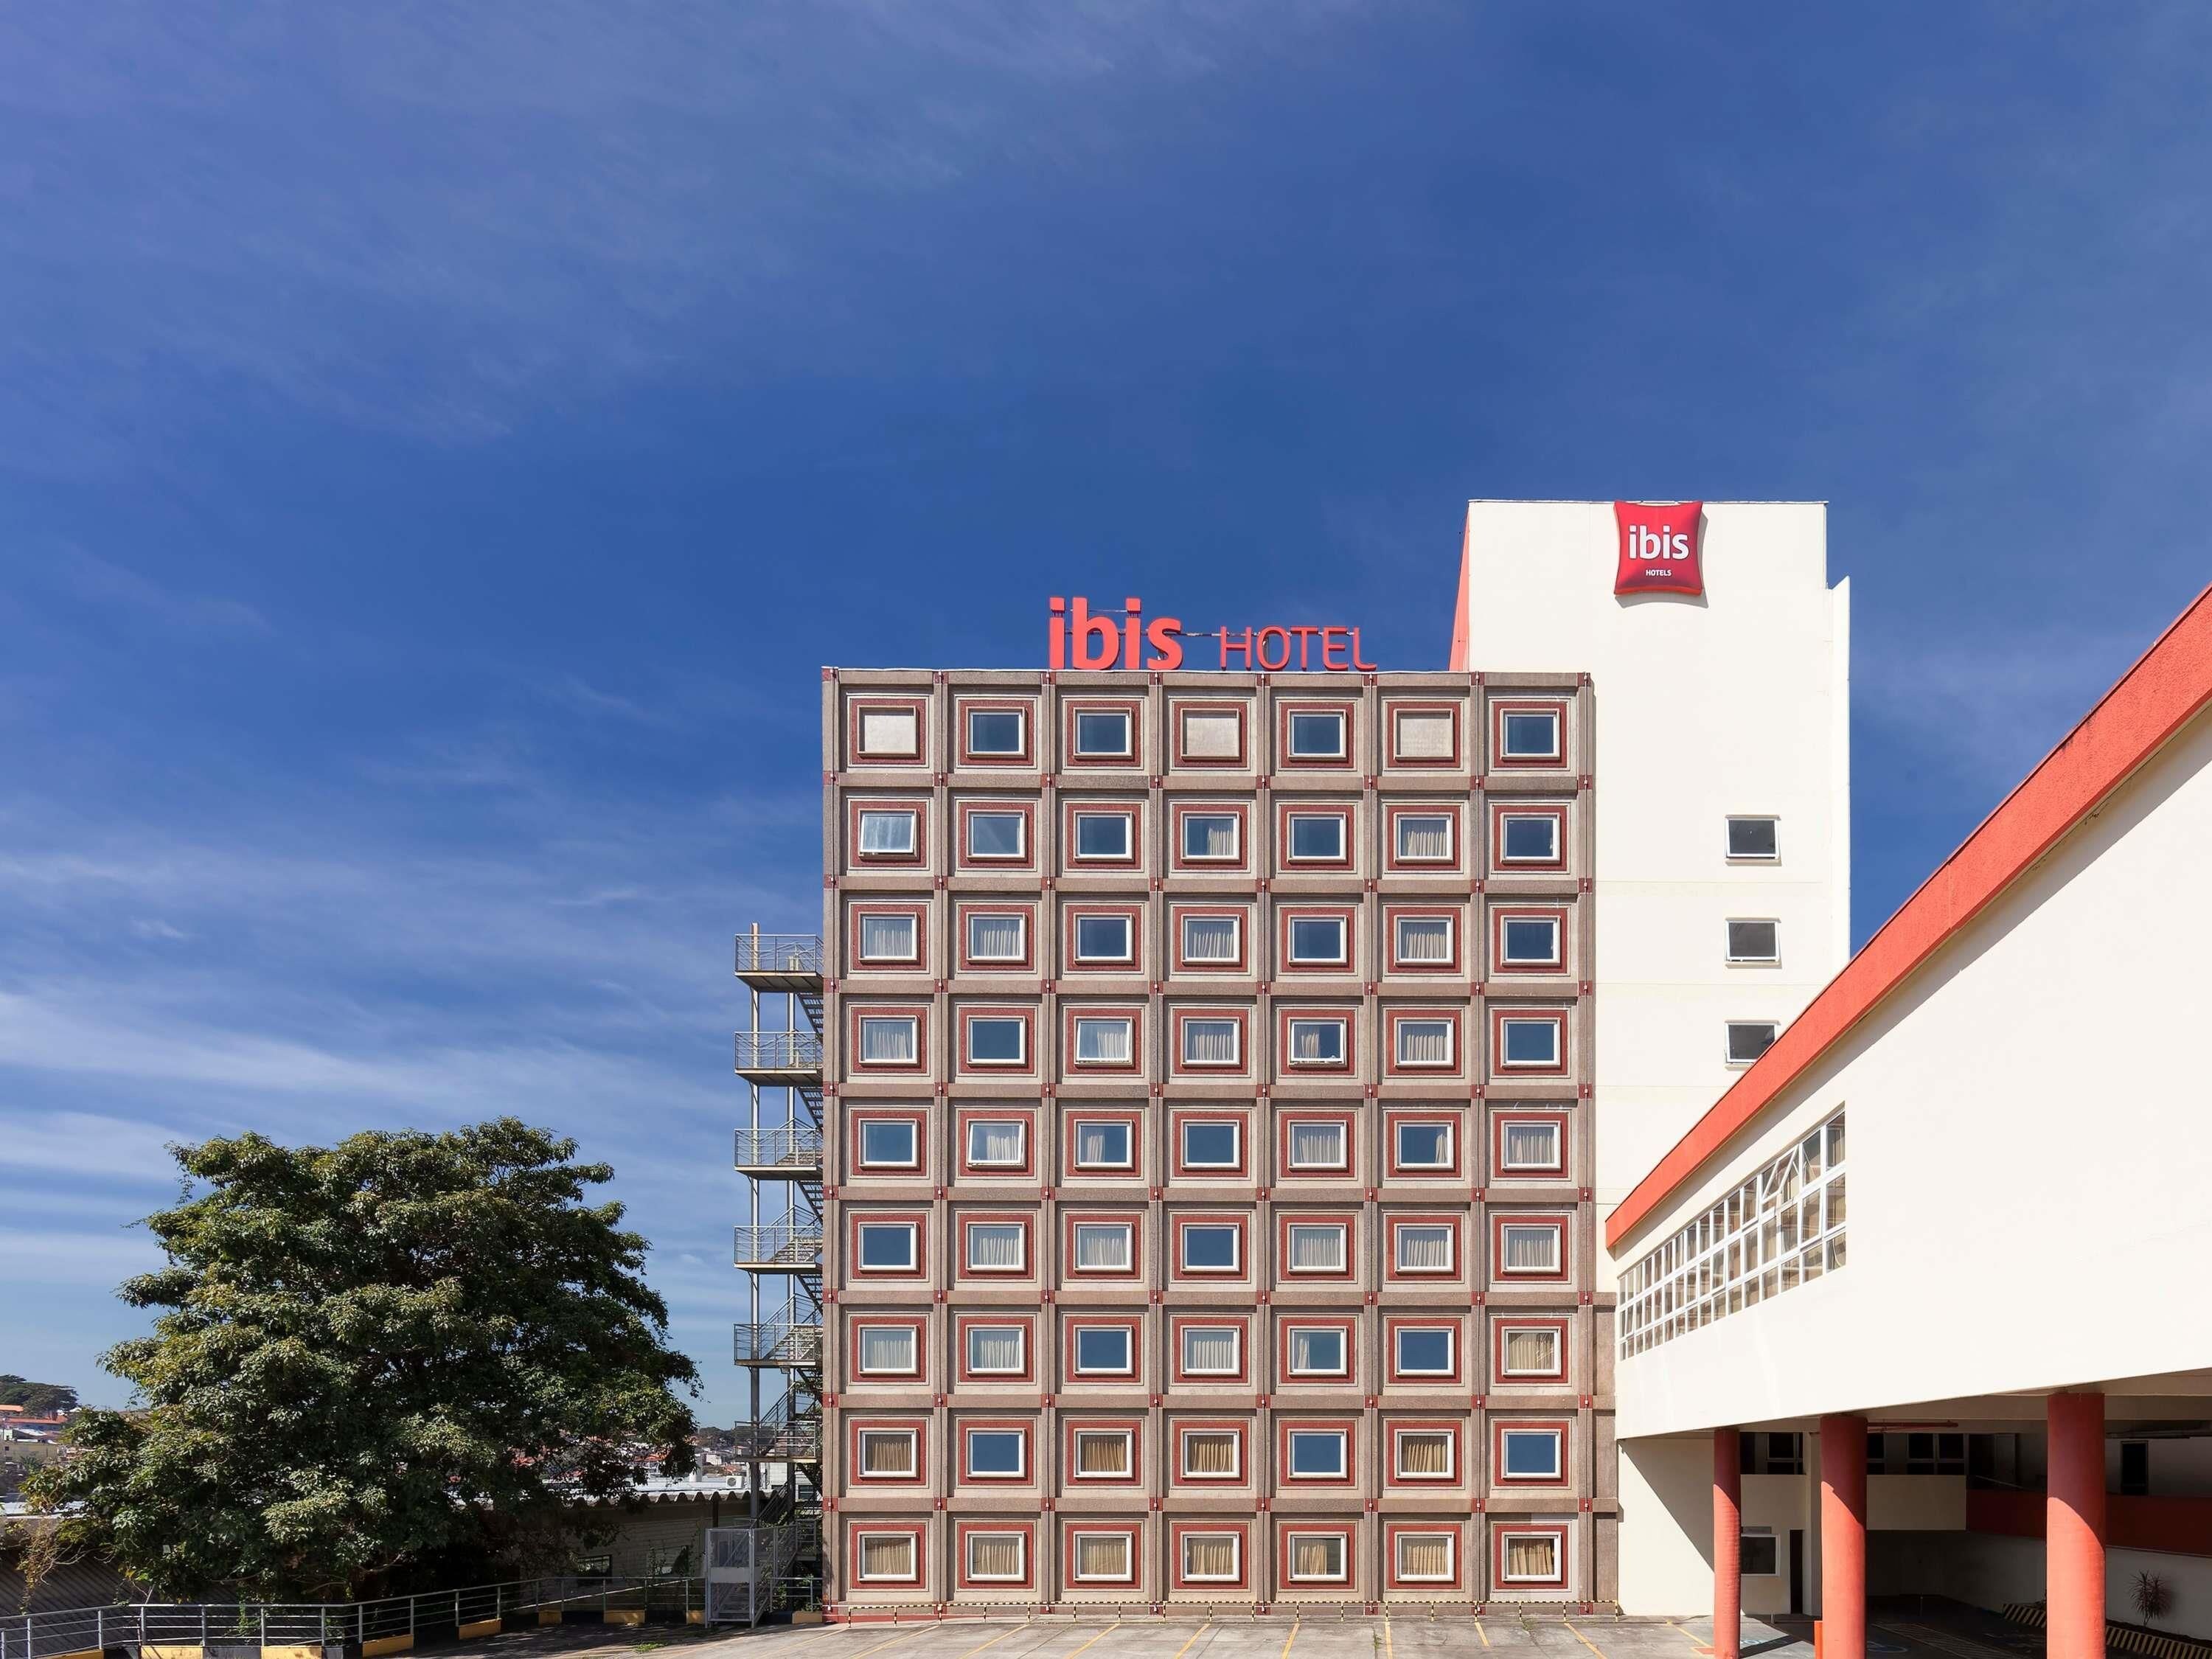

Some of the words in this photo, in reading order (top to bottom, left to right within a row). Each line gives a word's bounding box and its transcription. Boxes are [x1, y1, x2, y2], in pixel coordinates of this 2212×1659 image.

[1630, 526, 1689, 559] ibis
[1049, 597, 1183, 669] ibis
[1220, 626, 1377, 670] HOTEL
